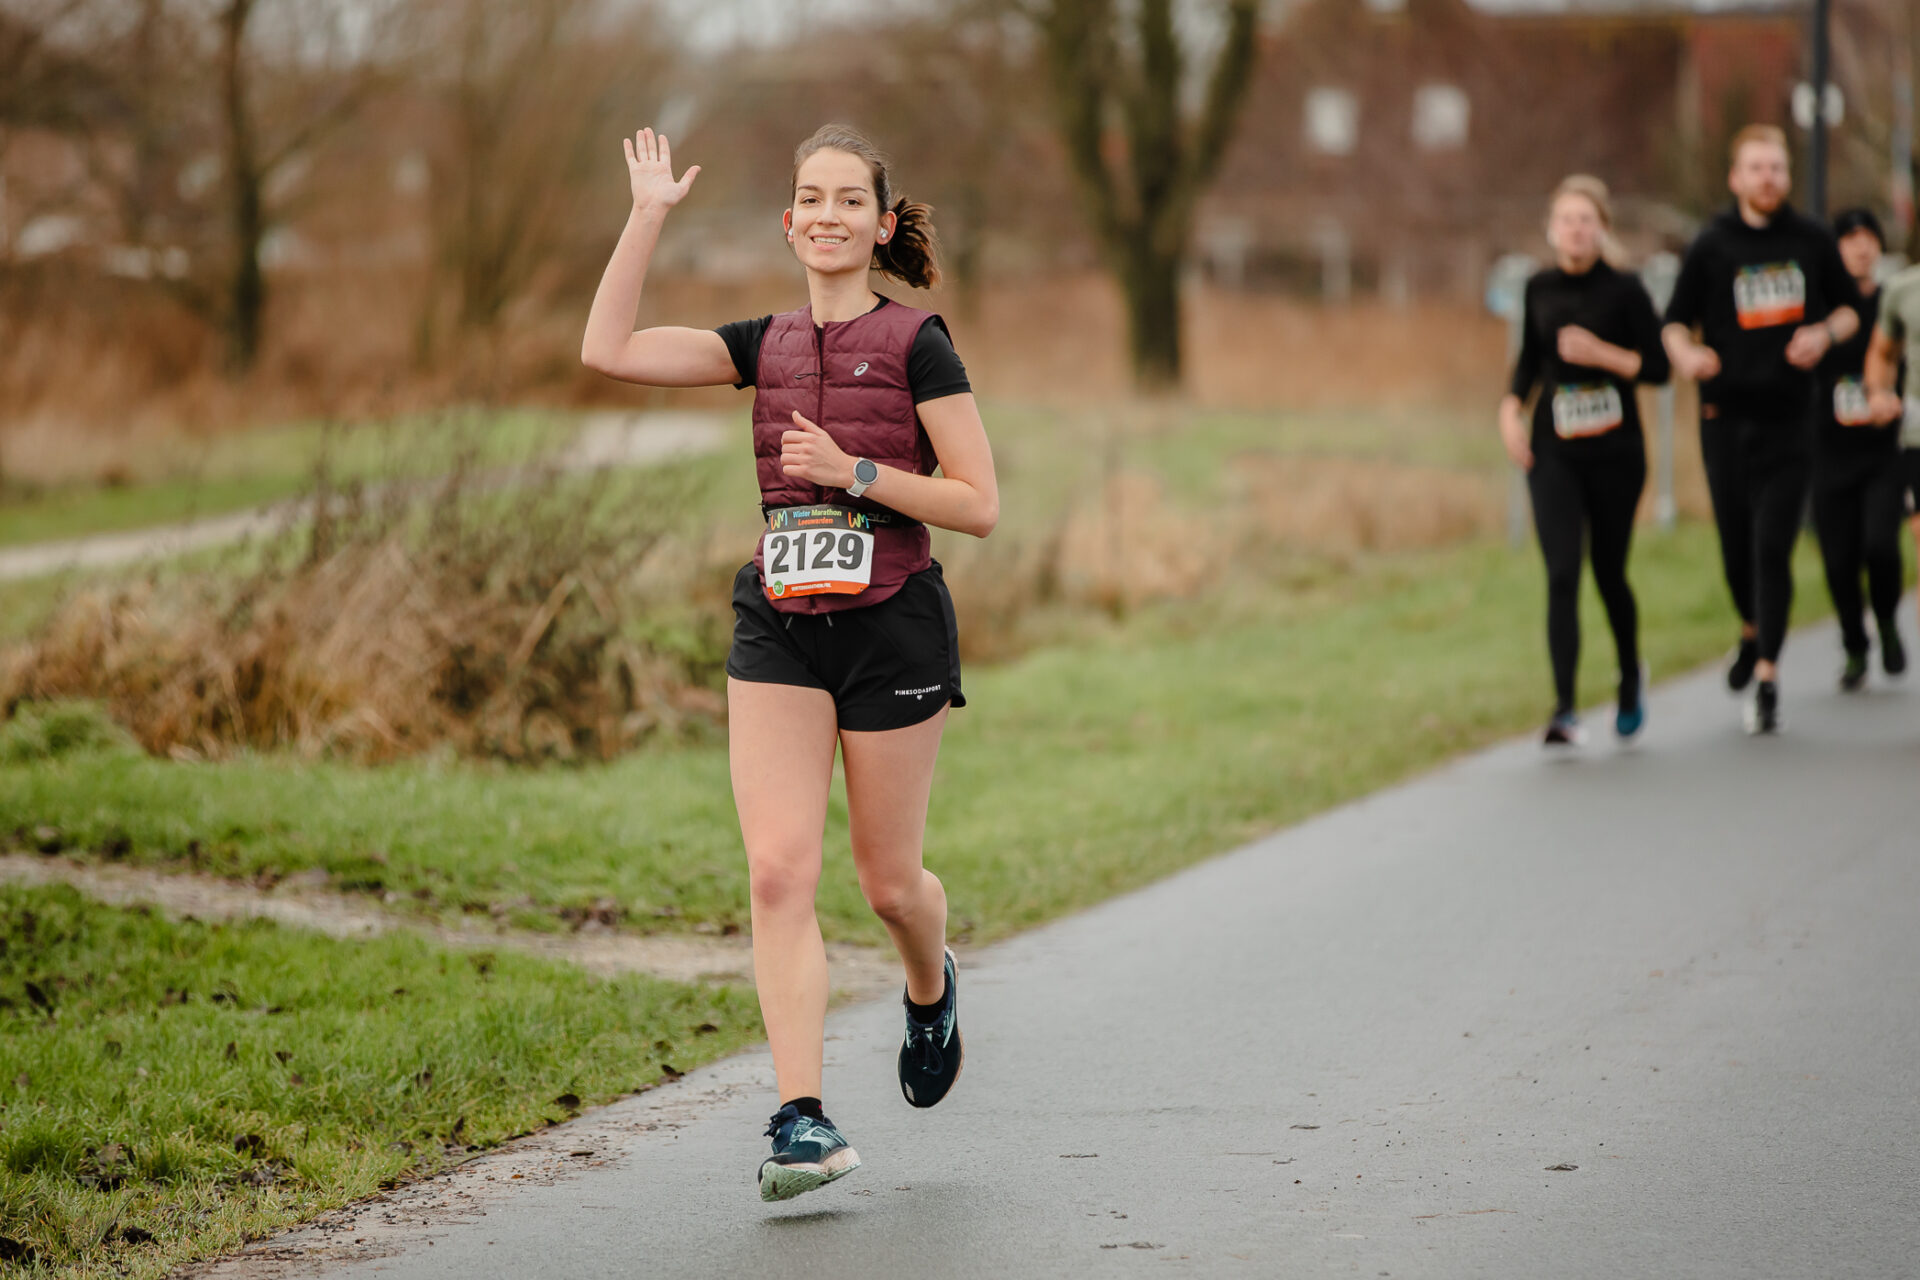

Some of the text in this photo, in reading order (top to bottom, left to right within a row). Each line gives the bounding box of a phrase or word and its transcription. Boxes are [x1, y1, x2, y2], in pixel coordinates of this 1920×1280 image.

[792, 508, 842, 518] Winter Marathon
[770, 531, 864, 574] 2129
[894, 684, 941, 696] PINKSODASPORT
